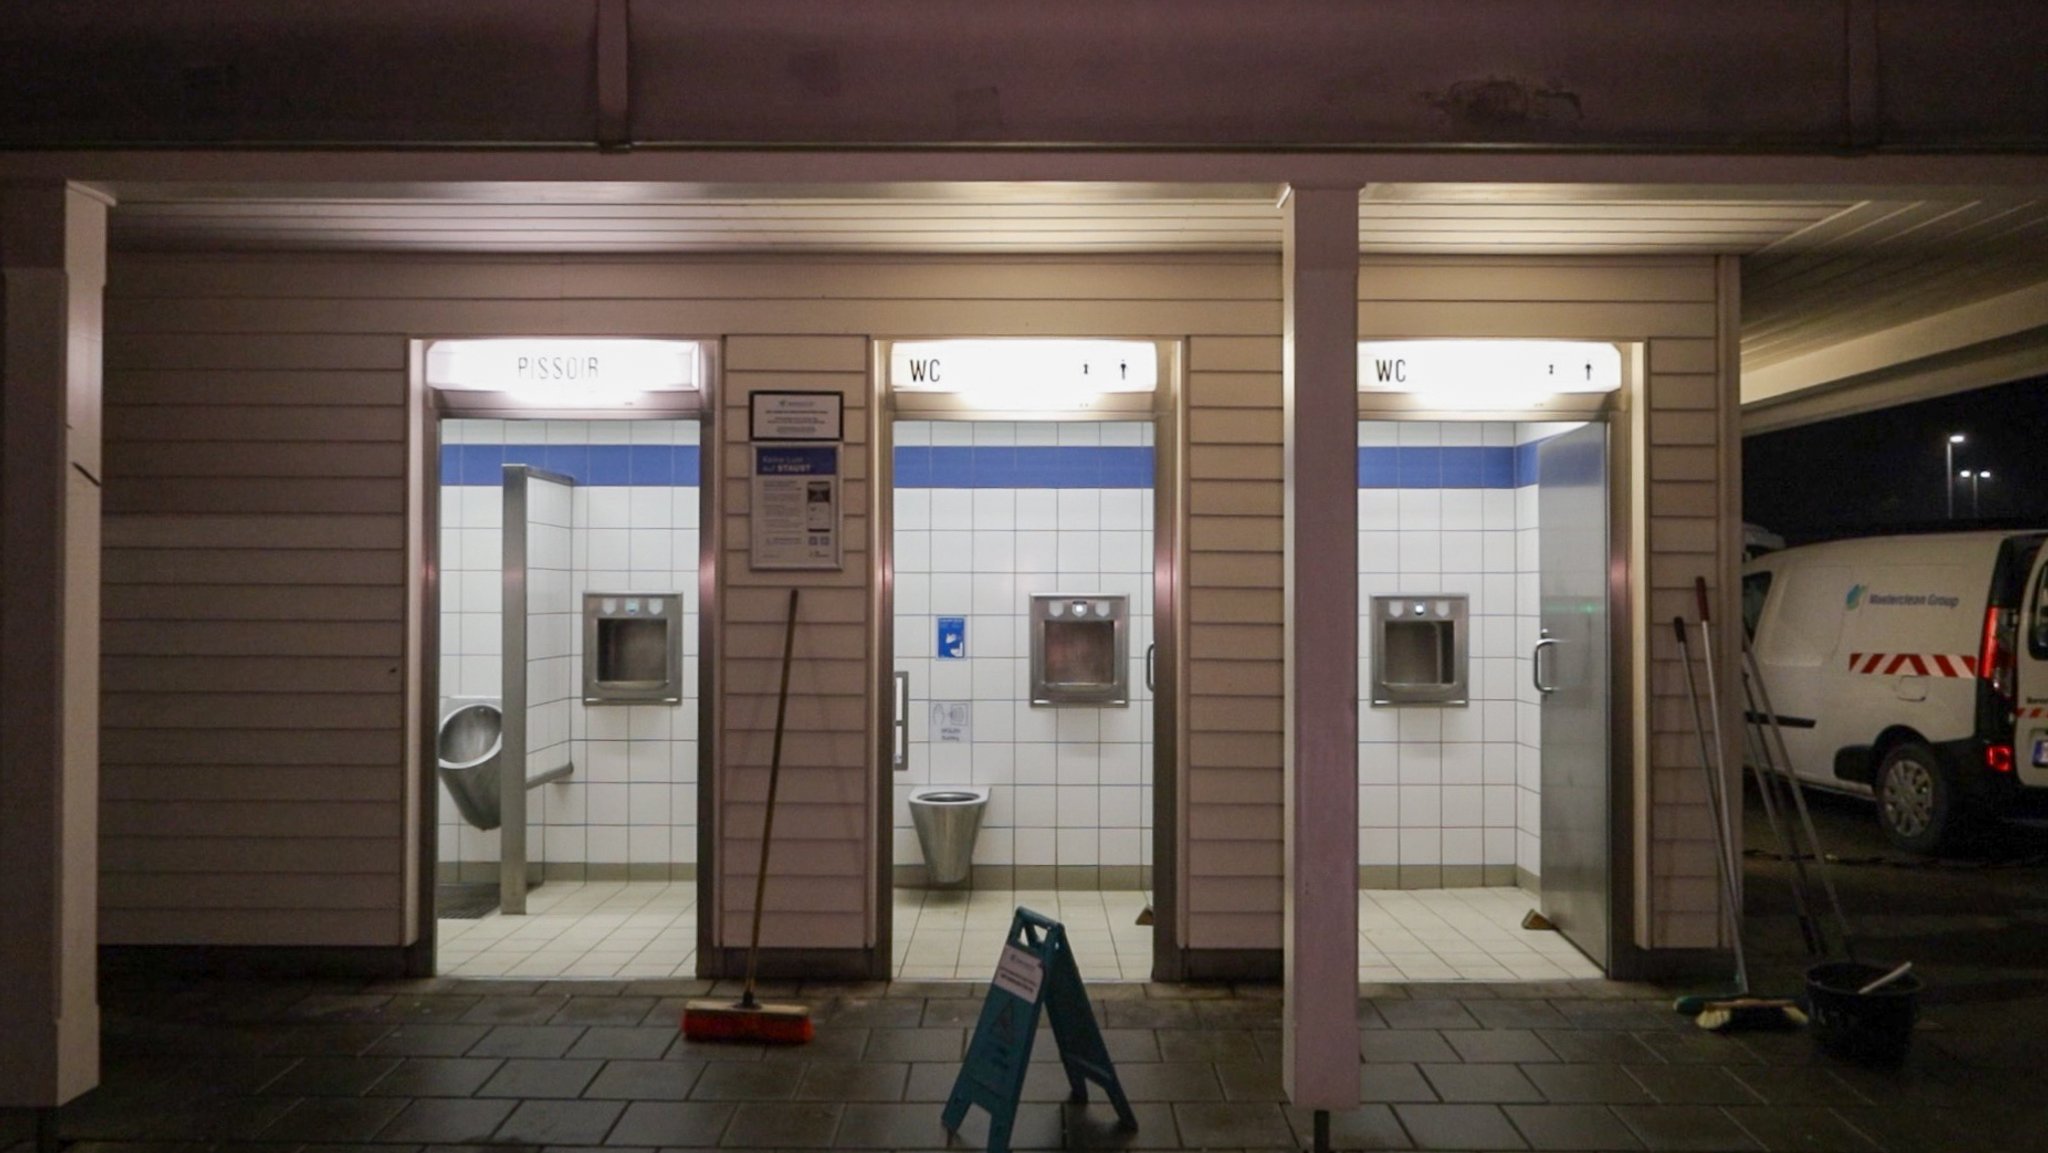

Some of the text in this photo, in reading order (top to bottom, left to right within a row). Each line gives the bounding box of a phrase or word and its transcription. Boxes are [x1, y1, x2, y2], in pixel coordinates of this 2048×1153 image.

[518, 356, 599, 380] PISSOIR
[909, 358, 941, 383] WC
[1375, 358, 1407, 383] WC
